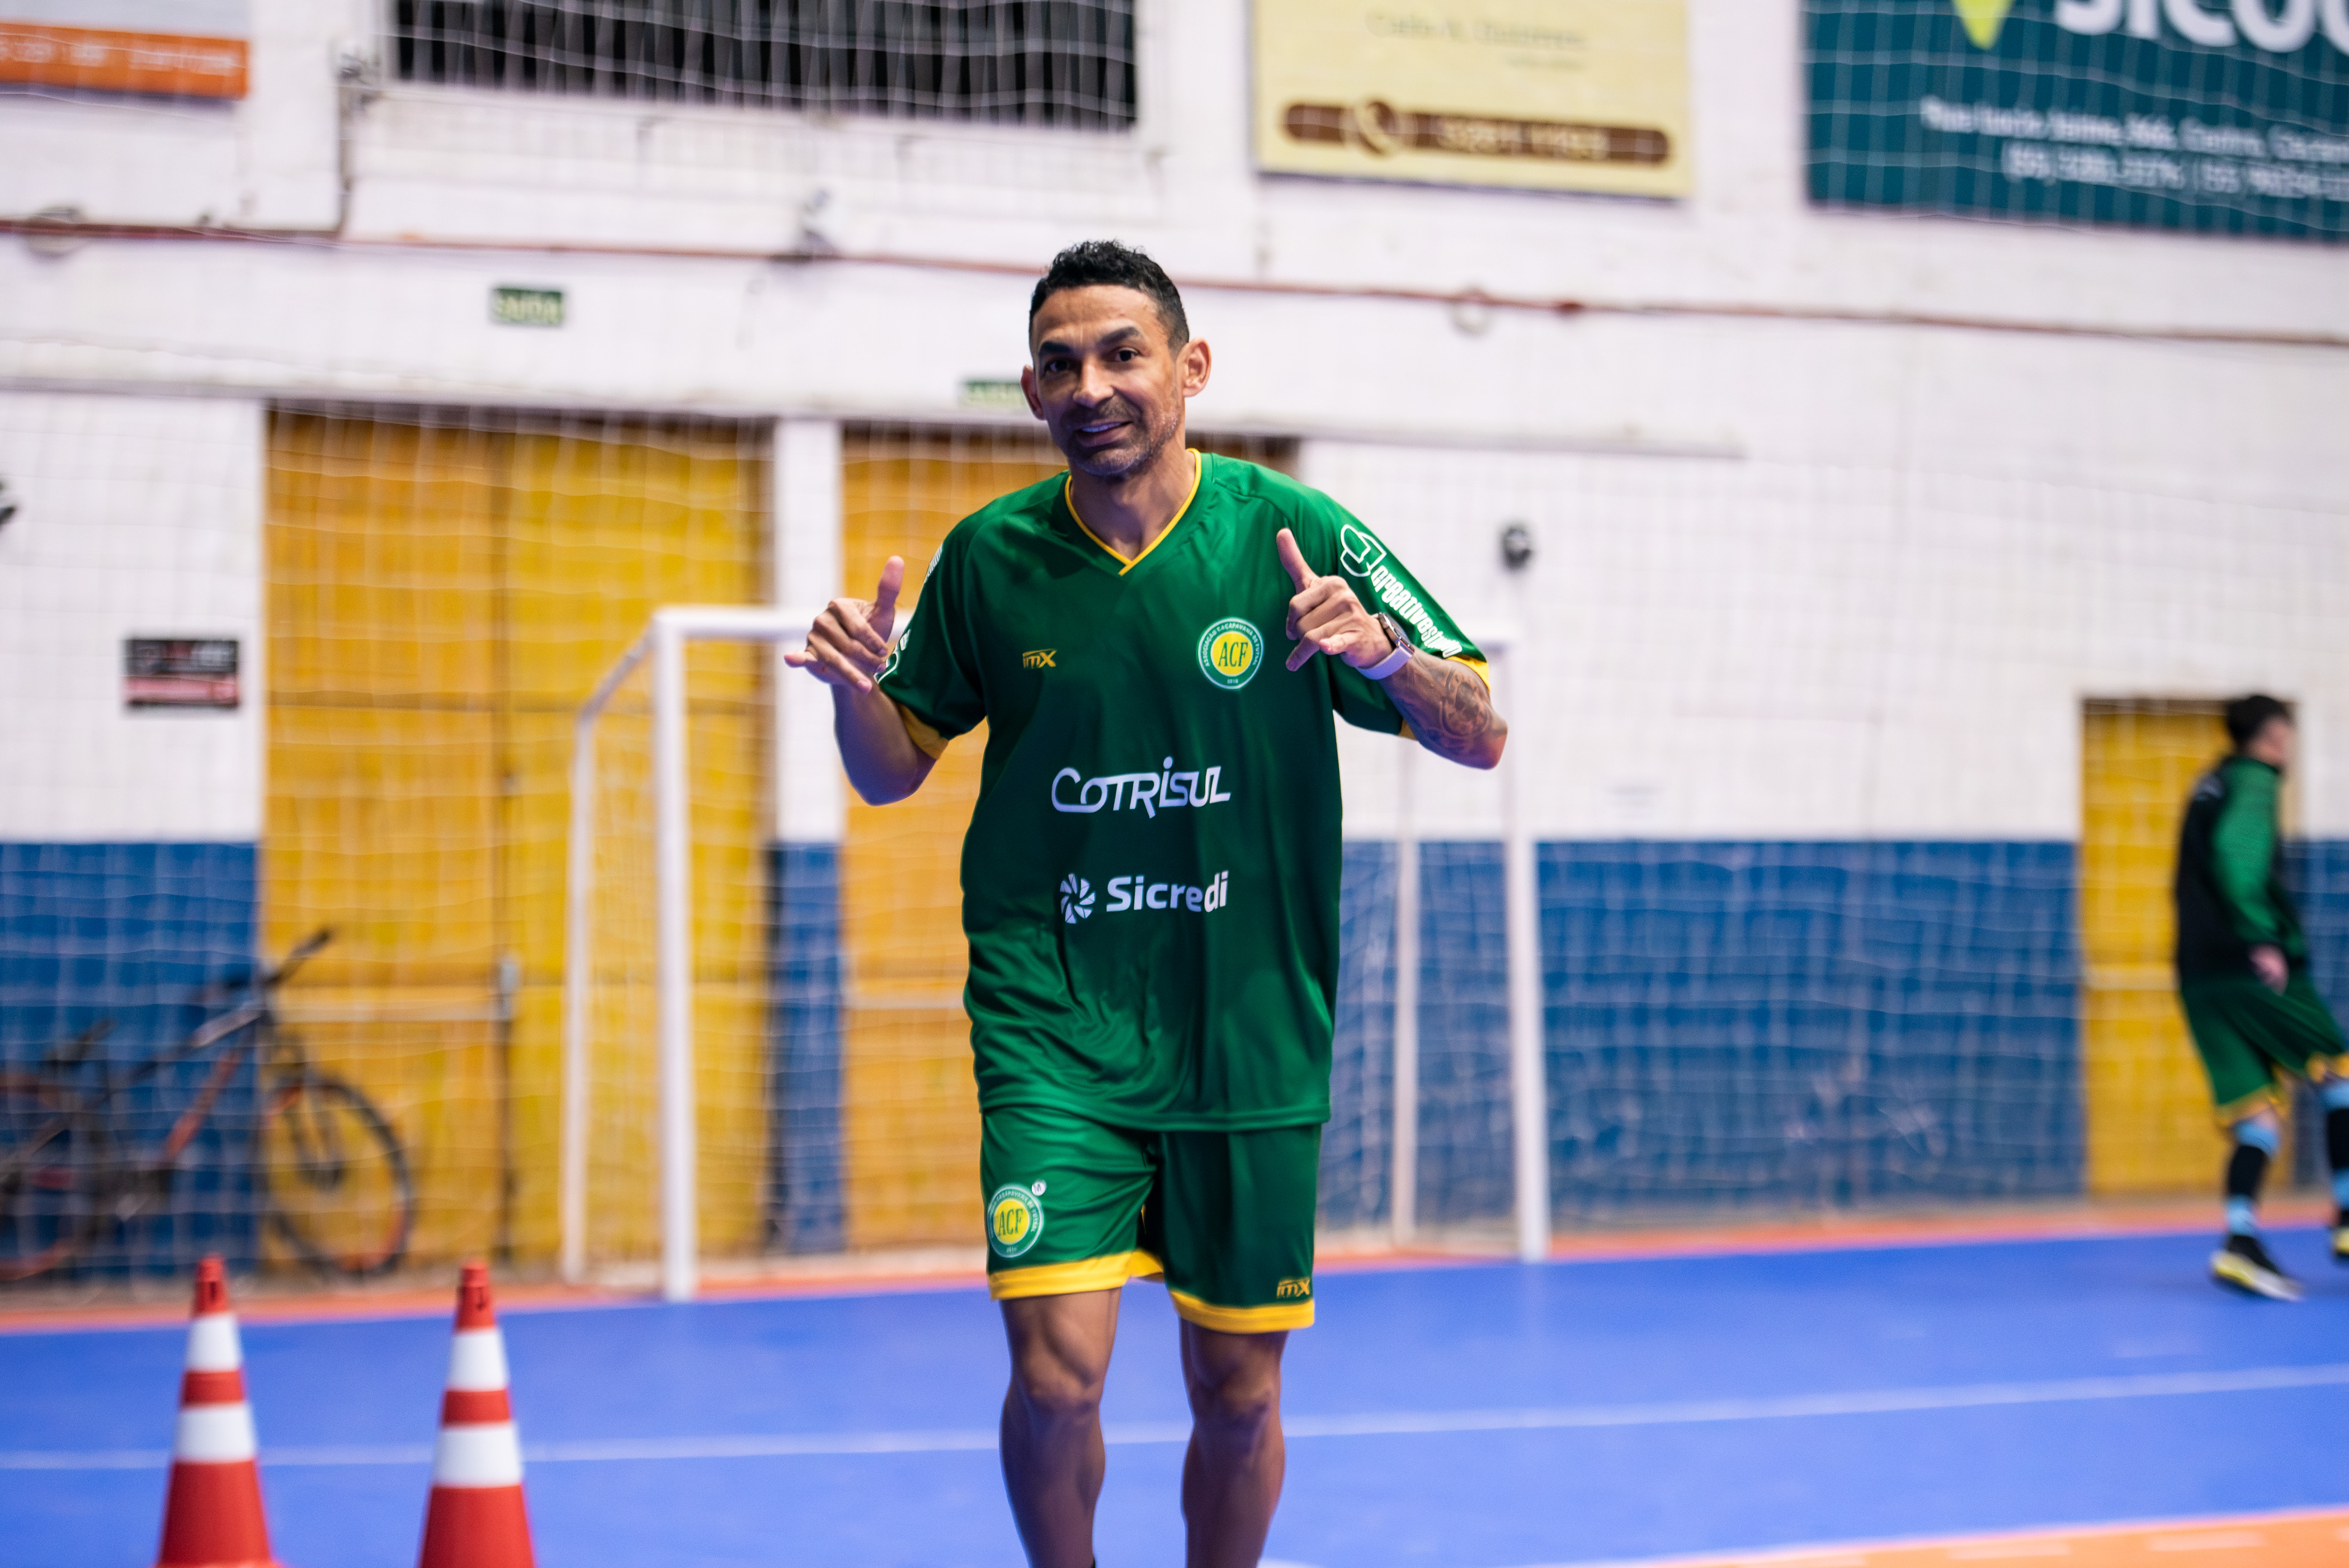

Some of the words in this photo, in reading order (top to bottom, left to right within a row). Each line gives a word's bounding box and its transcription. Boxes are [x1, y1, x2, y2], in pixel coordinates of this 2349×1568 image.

[1218, 641, 1248, 667] ACF
[1106, 870, 1229, 913] Sicredi
[998, 1208, 1023, 1236] ACF
